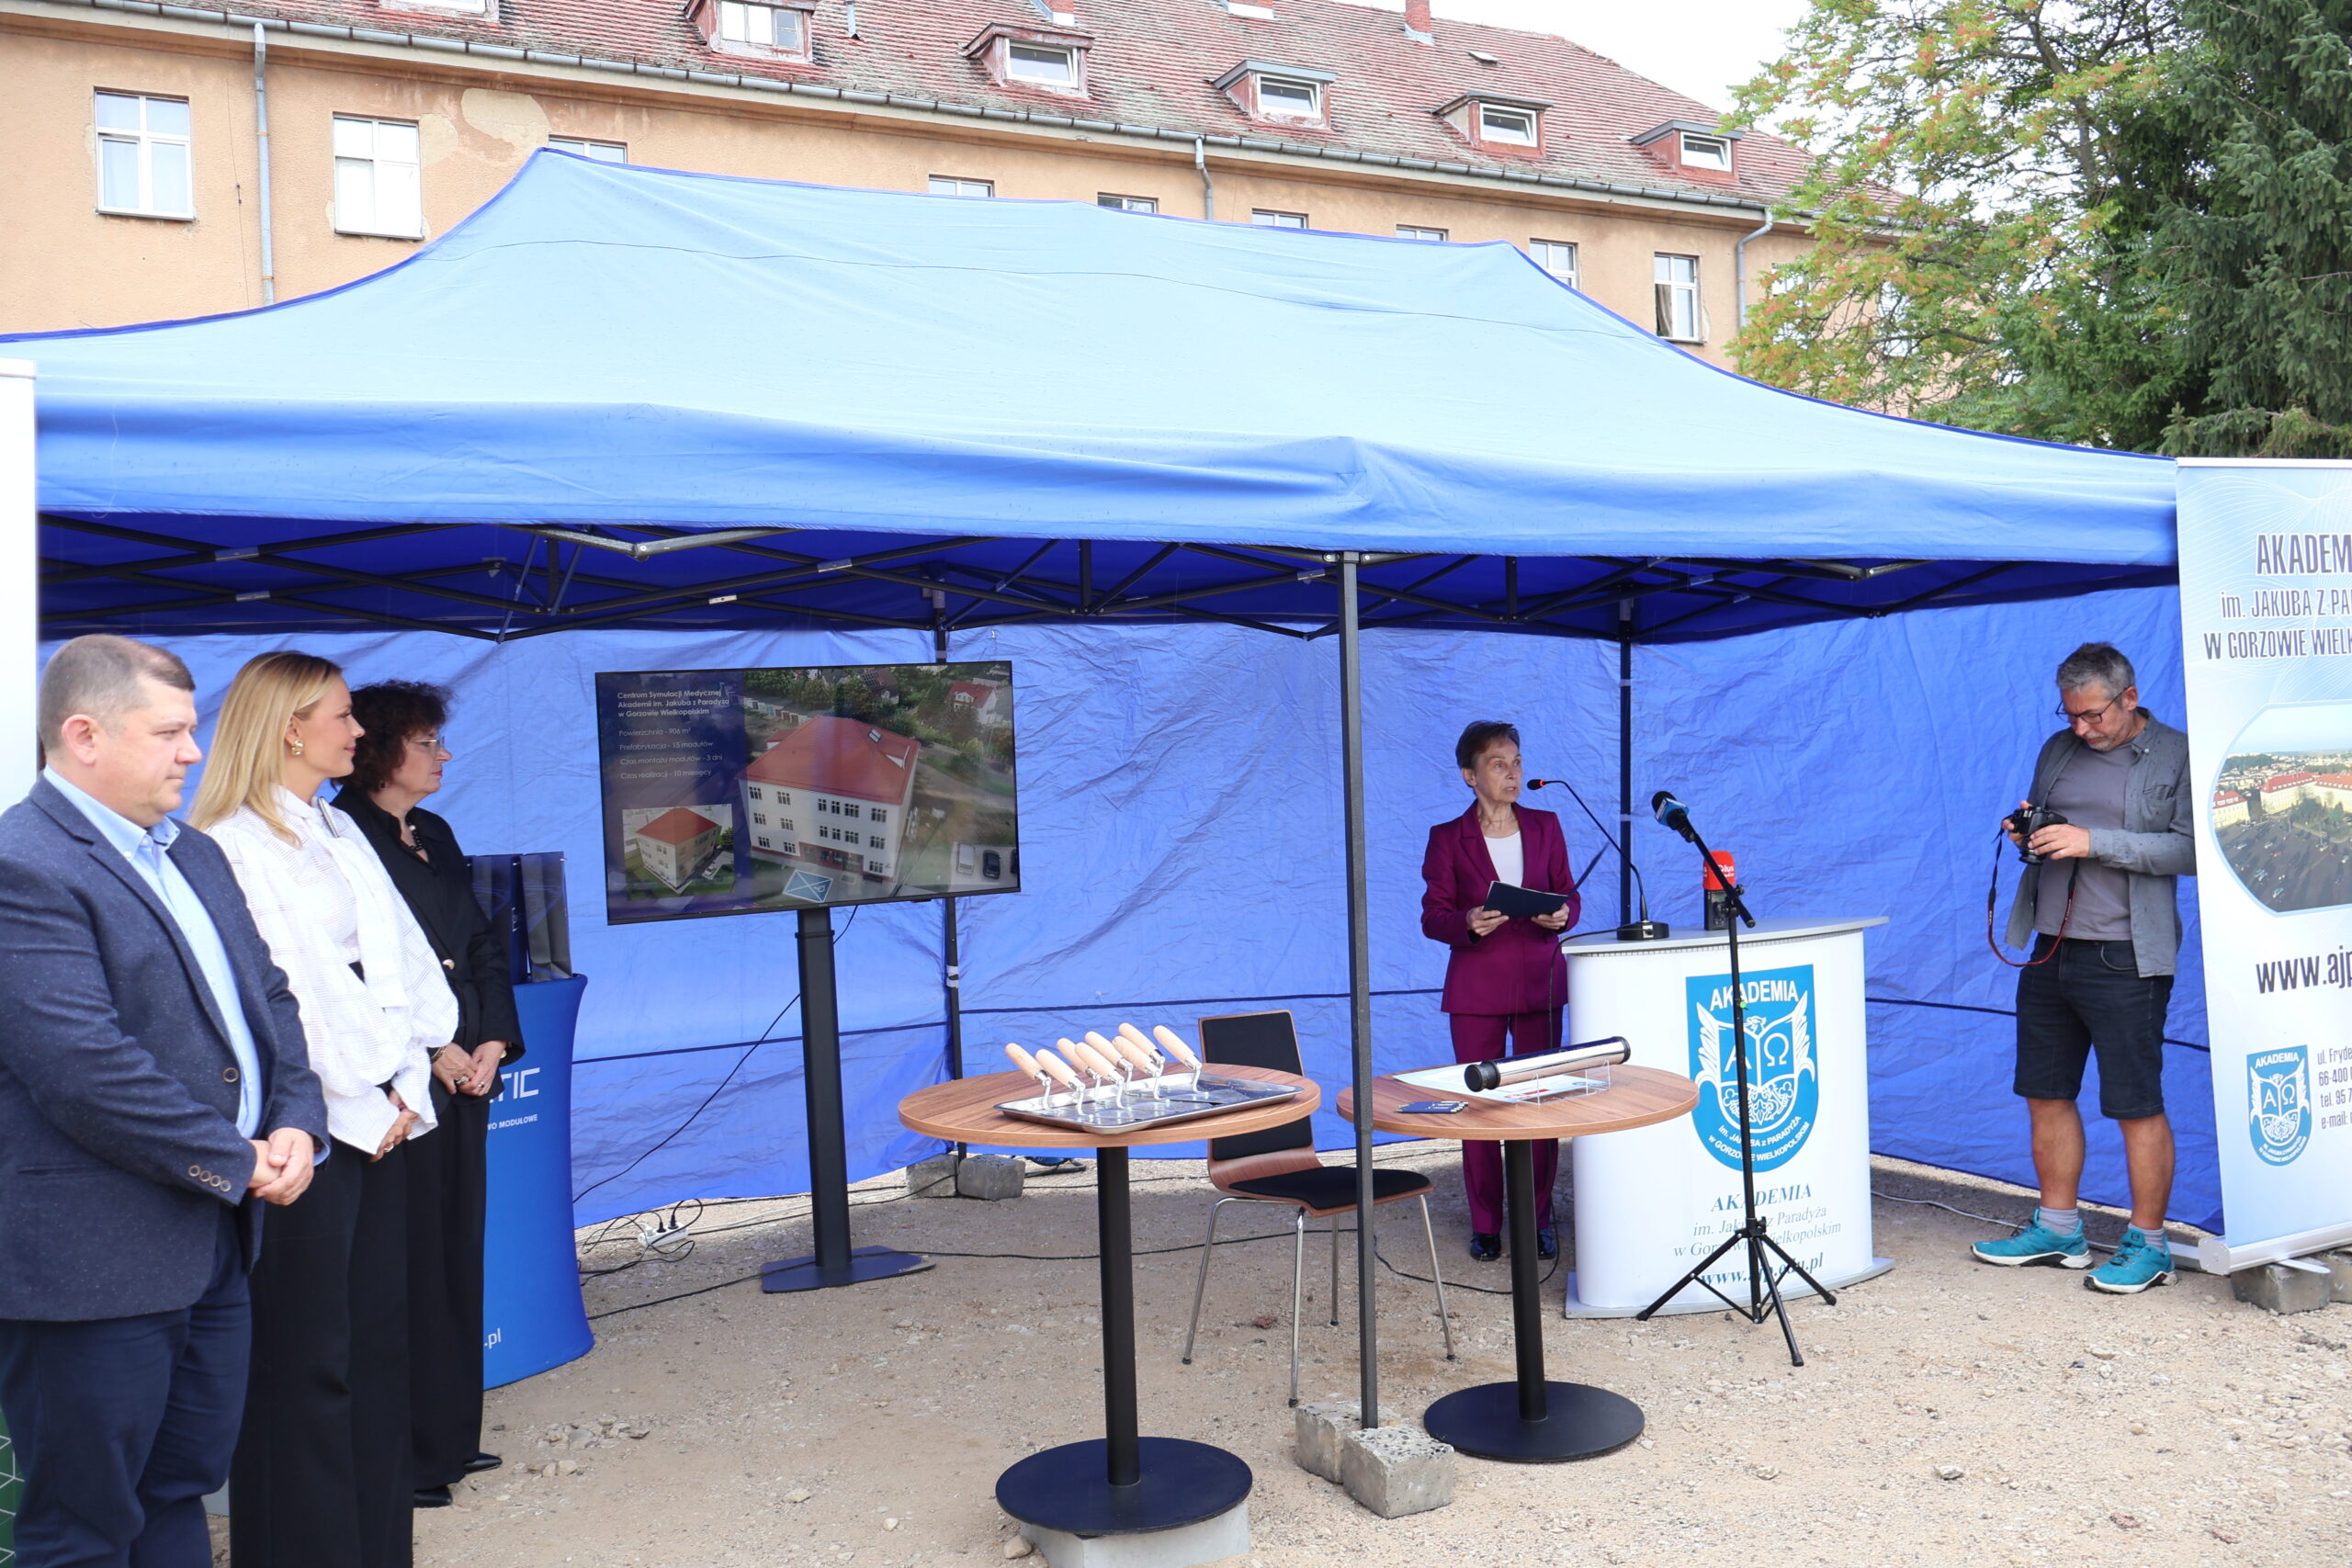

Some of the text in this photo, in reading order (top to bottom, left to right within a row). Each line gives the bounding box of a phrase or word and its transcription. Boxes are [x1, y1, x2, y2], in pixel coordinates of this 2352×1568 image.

[2221, 592, 2246, 618] im.
[2252, 590, 2312, 617] JAKUBA
[2316, 589, 2325, 615] Z
[2203, 633, 2222, 660] W
[2228, 629, 2307, 659] GORZOWIE
[660, 707, 709, 716] Wielkopolskim
[665, 699, 691, 707] Jakuba
[618, 728, 663, 737] Powierzchnia
[620, 772, 638, 780] Czas
[2255, 1052, 2300, 1069] AKADEMIA
[2318, 1066, 2348, 1087] 66-400
[2320, 1092, 2335, 1108] tel.
[2335, 1089, 2346, 1105] 95
[1757, 1122, 1810, 1162] WIELKOPOLSKIM
[1693, 1222, 1713, 1235] im.
[1777, 1206, 1826, 1226] Paradyża
[1674, 1246, 1686, 1257] w
[1768, 1221, 1841, 1246] ielkopolskim
